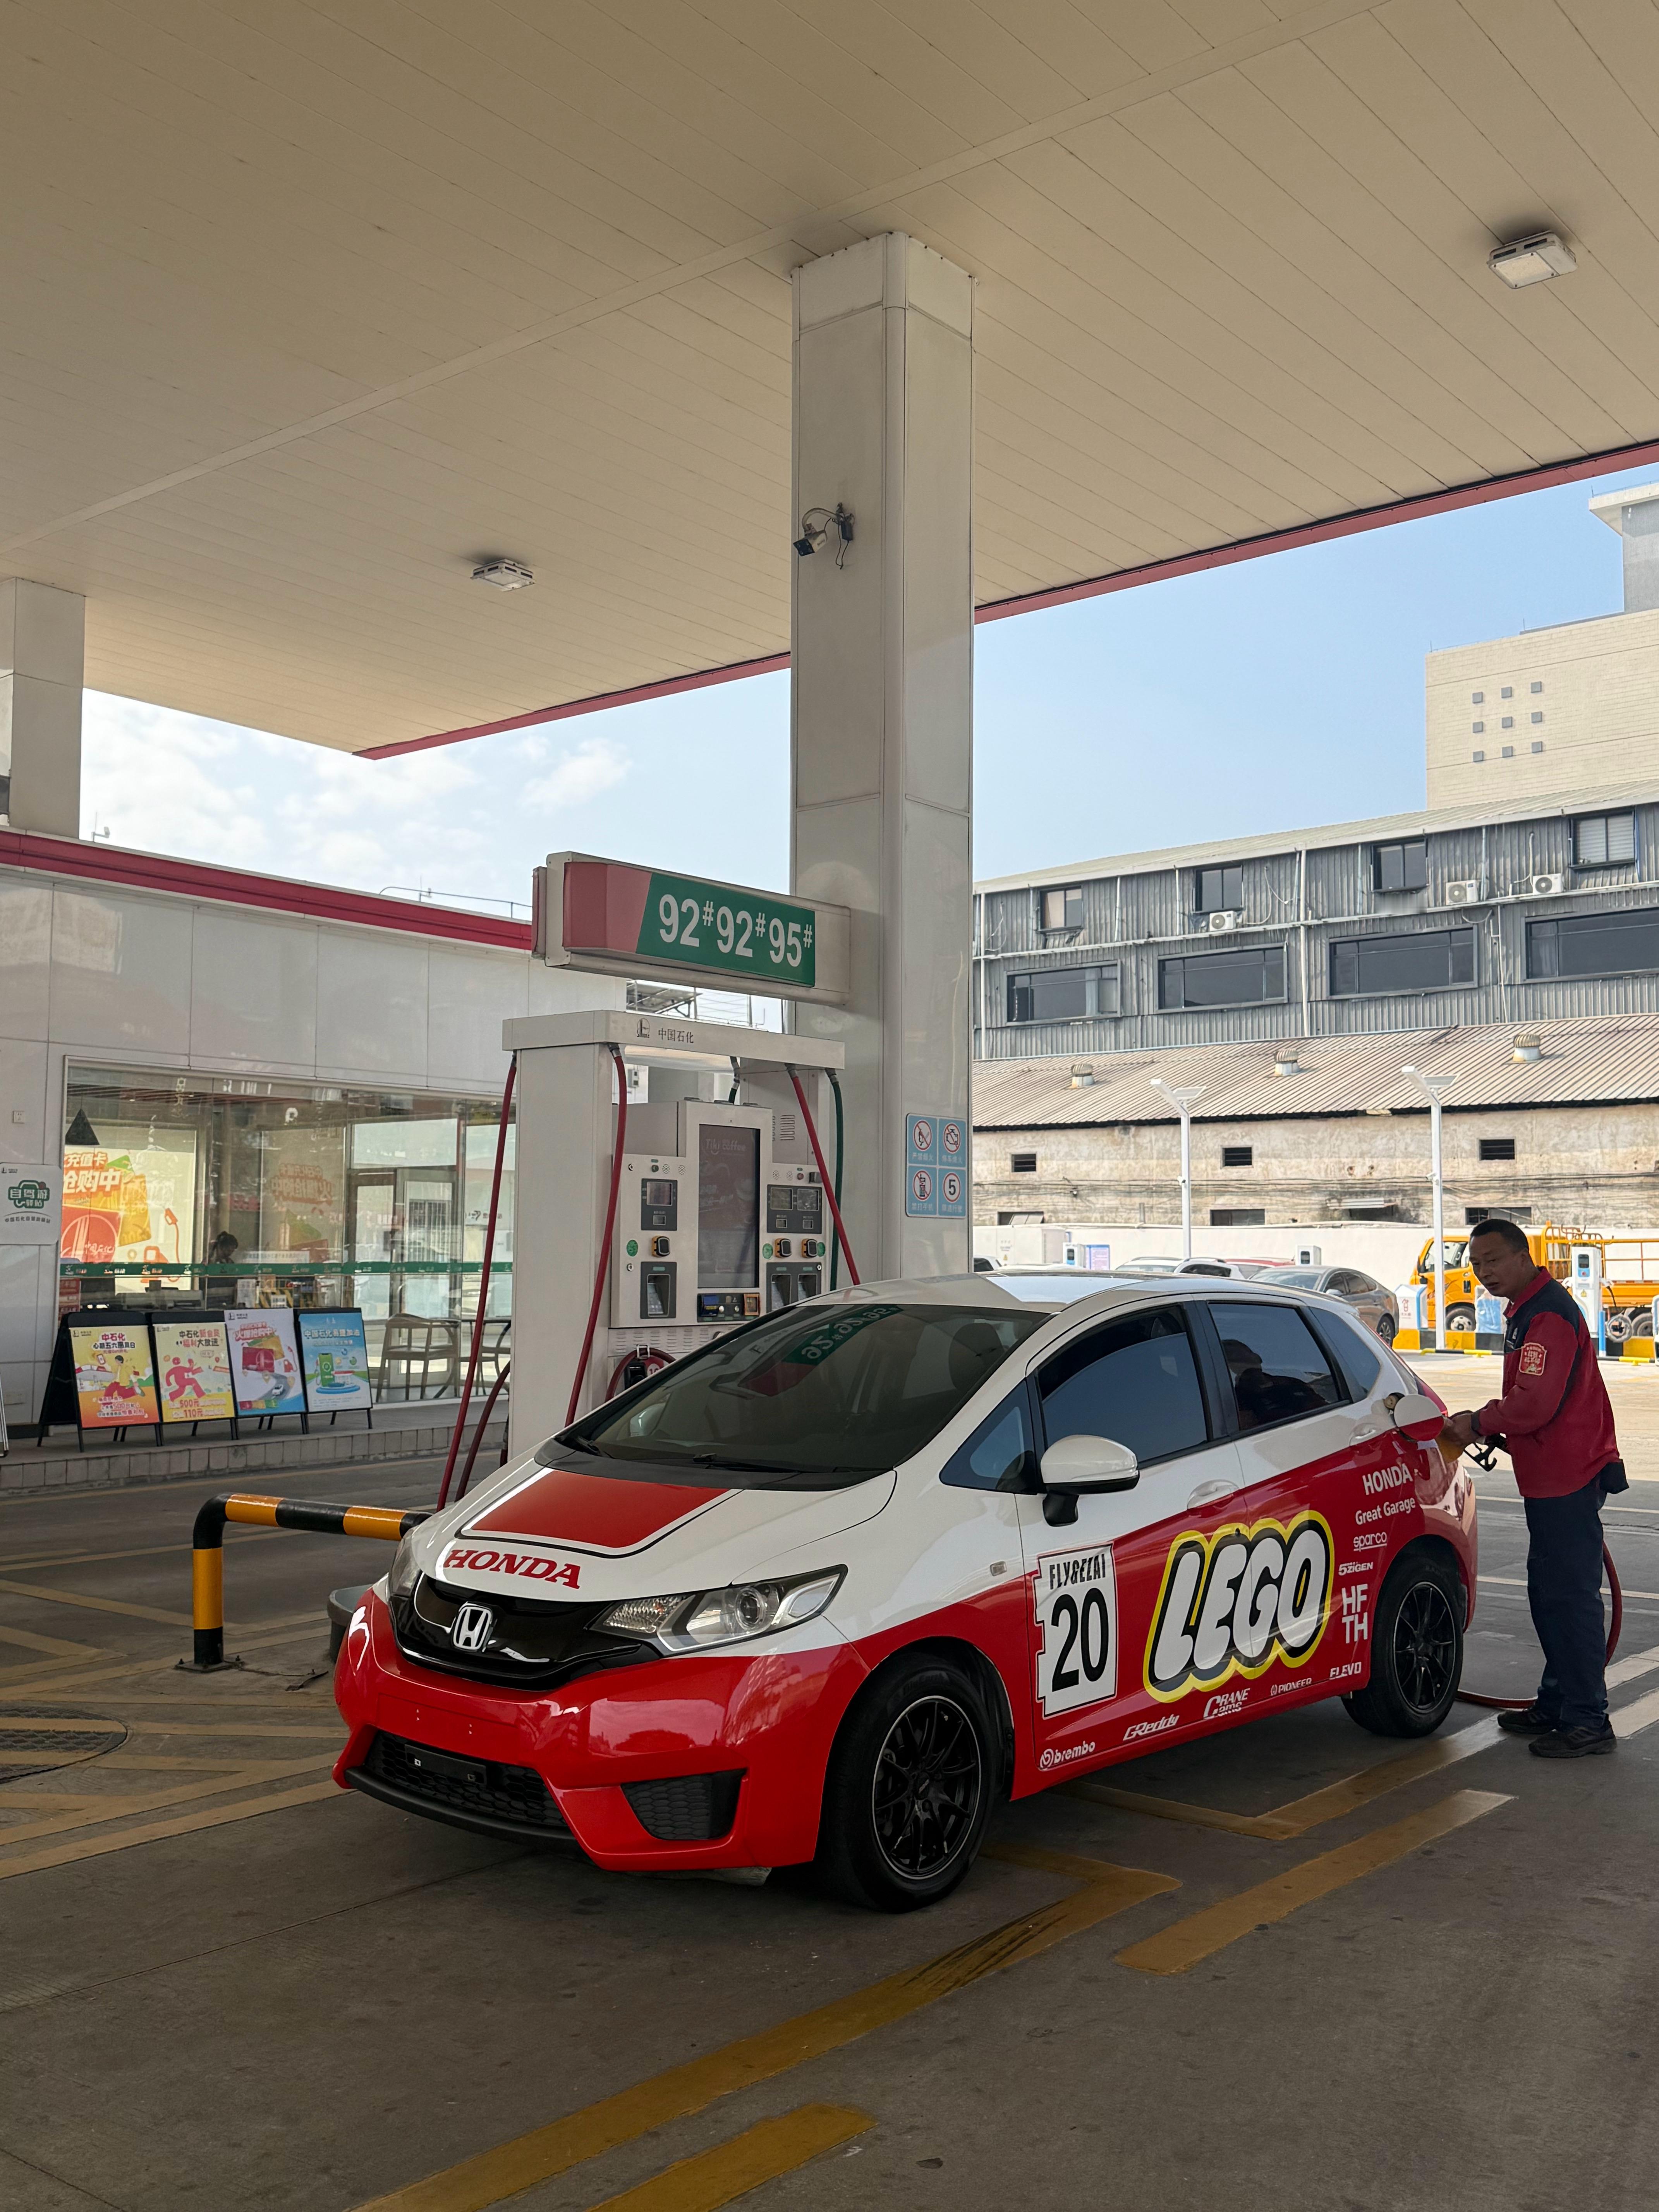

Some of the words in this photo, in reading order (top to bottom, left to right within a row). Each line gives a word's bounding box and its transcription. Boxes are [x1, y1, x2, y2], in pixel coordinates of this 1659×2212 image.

[659, 894, 714, 947] 92#
[716, 905, 766, 957] 92#
[769, 917, 812, 967] 95#
[658, 1028, 694, 1043] 中国石化
[64, 1152, 107, 1168] 充值卡
[949, 1179, 956, 1195] 5
[101, 1333, 125, 1341] 中石化
[1362, 1463, 1413, 1495] HONDA
[1355, 1505, 1382, 1525] Great
[1383, 1498, 1415, 1516] Garage
[1353, 1532, 1387, 1551] sparco
[443, 1549, 580, 1589] HONDA
[1153, 1529, 1326, 1681] LEGO
[1341, 1584, 1368, 1615] HF
[1051, 1588, 1109, 1692] 20
[1342, 1612, 1368, 1644] TH
[1054, 1740, 1096, 1764] brembo
